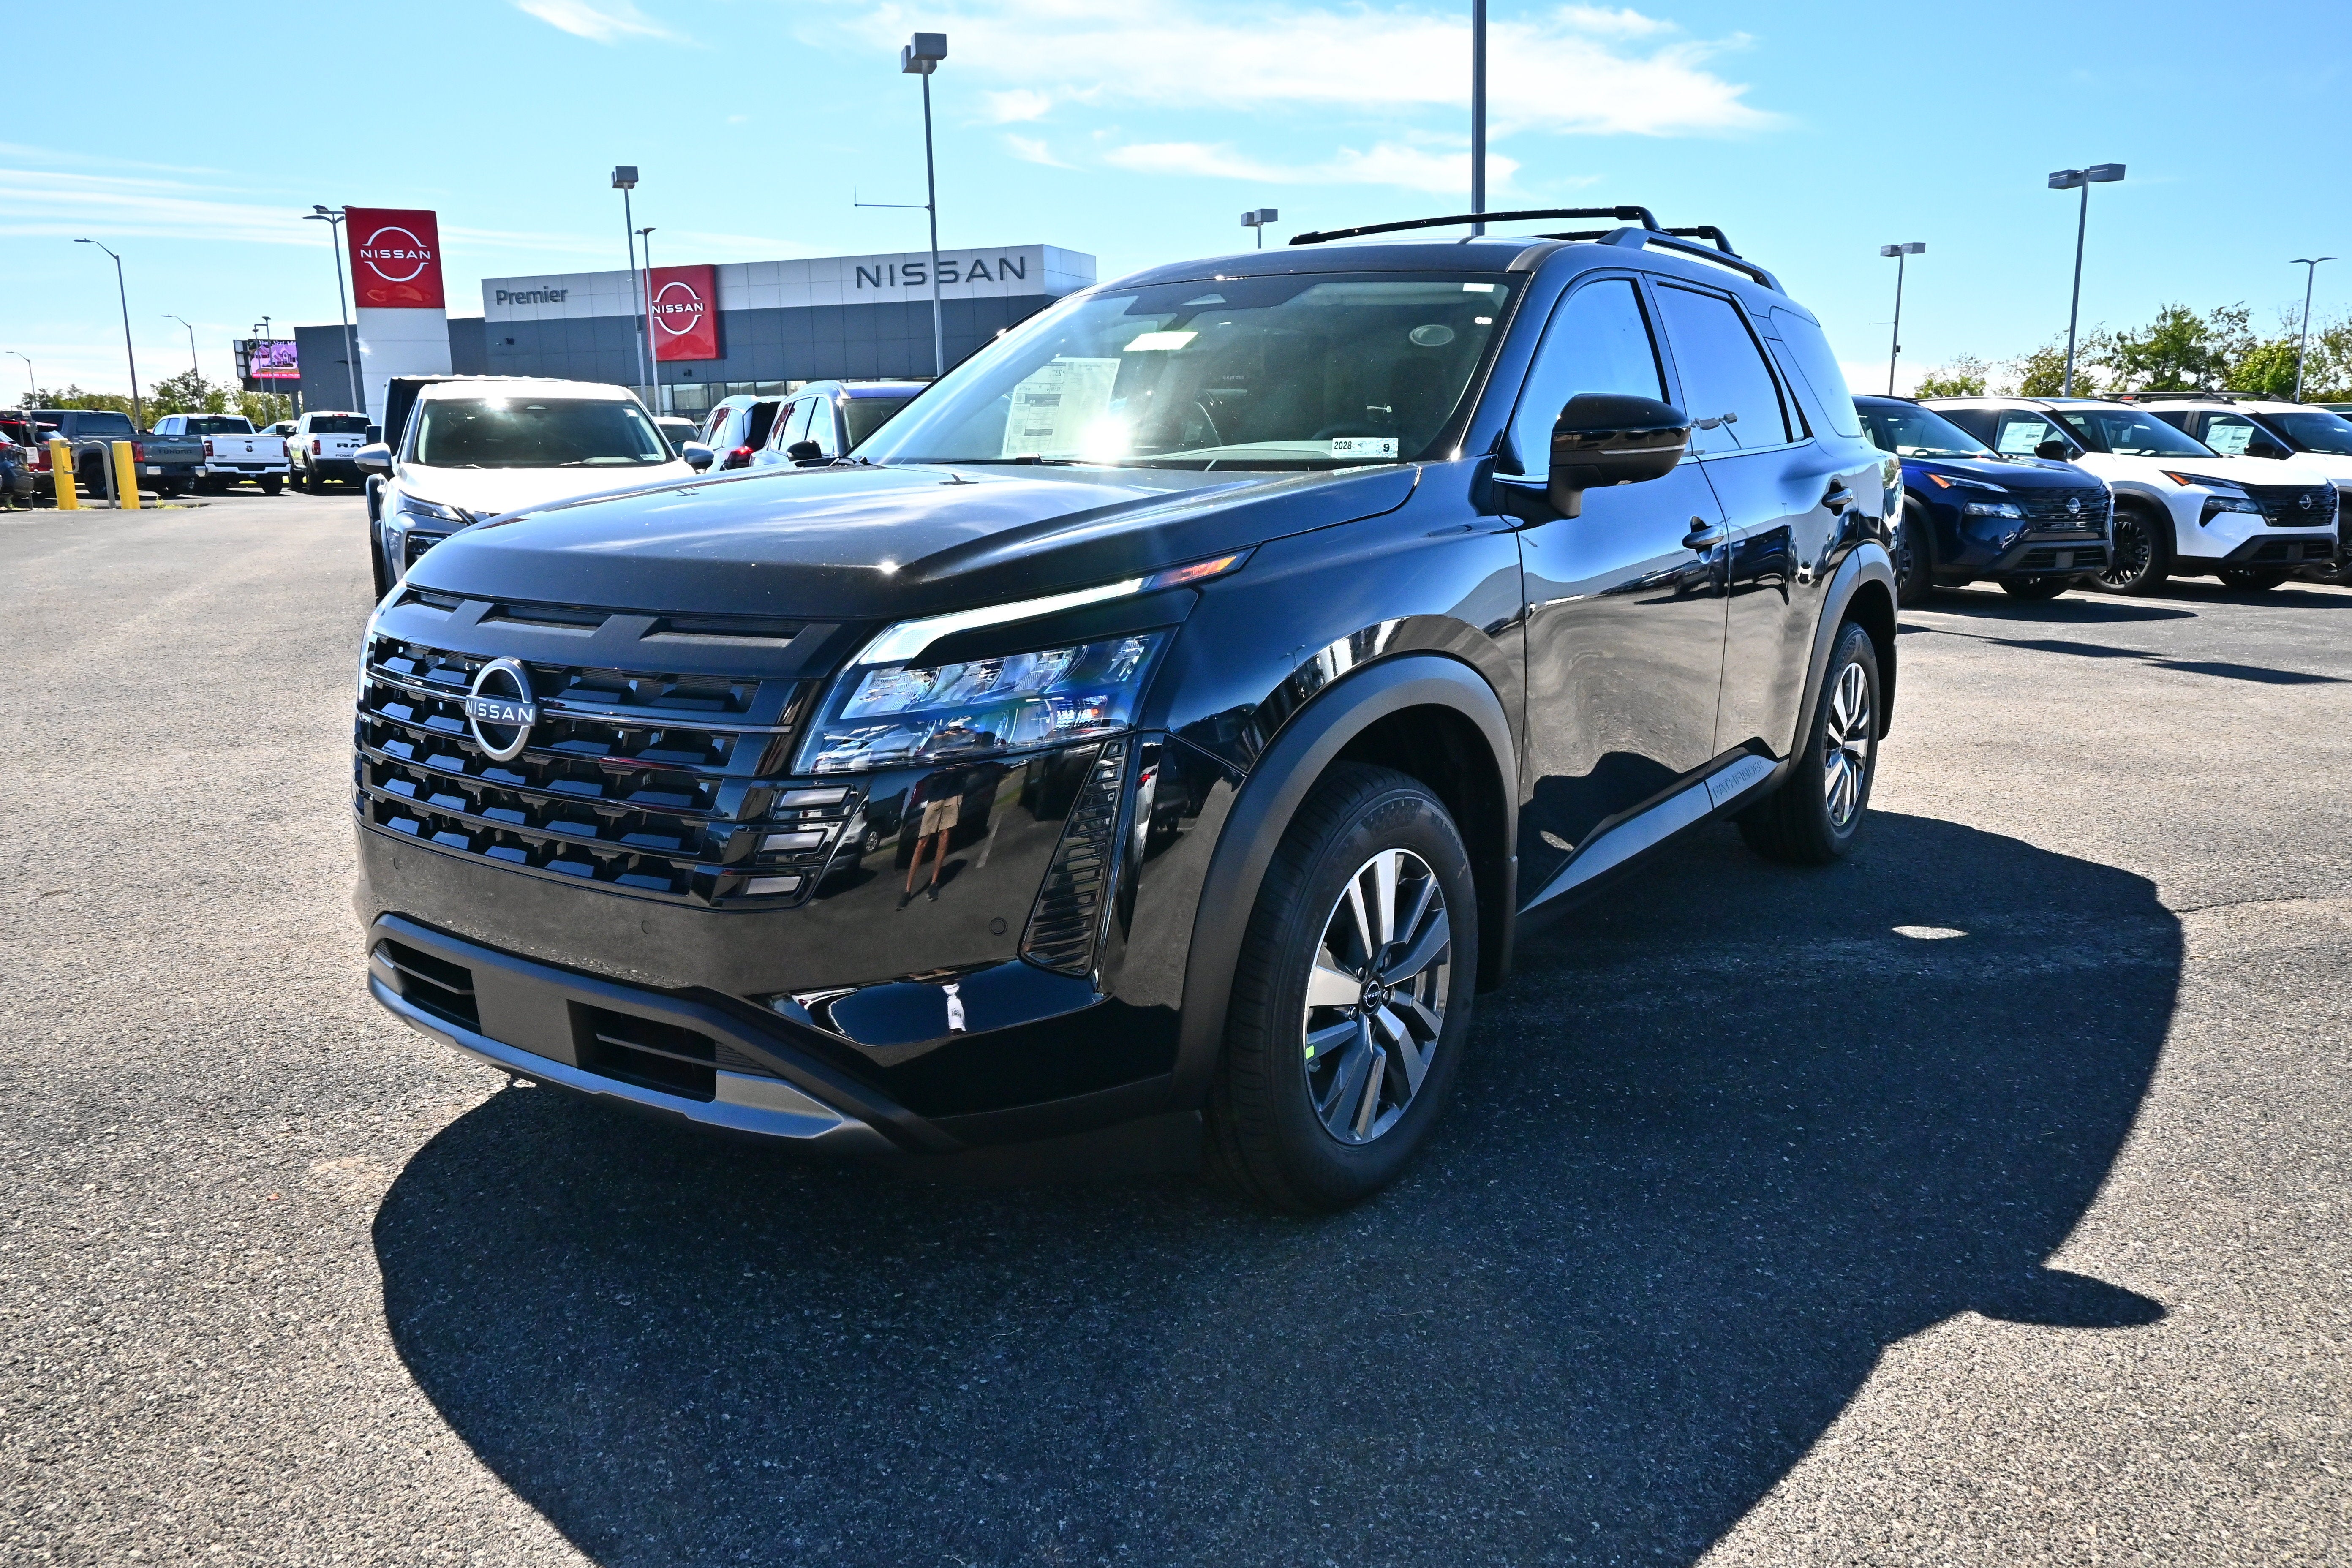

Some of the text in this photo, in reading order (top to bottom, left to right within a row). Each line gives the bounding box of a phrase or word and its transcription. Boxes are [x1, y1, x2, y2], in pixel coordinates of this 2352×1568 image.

[360, 249, 430, 259] NISSAN
[856, 256, 1025, 288] NISSAN
[496, 286, 568, 305] Premier
[652, 303, 703, 314] NISSAN
[1334, 441, 1352, 450] 2028
[1383, 443, 1390, 452] 9
[466, 699, 533, 722] NISSAN
[1712, 760, 1764, 798] PATHFINDER
